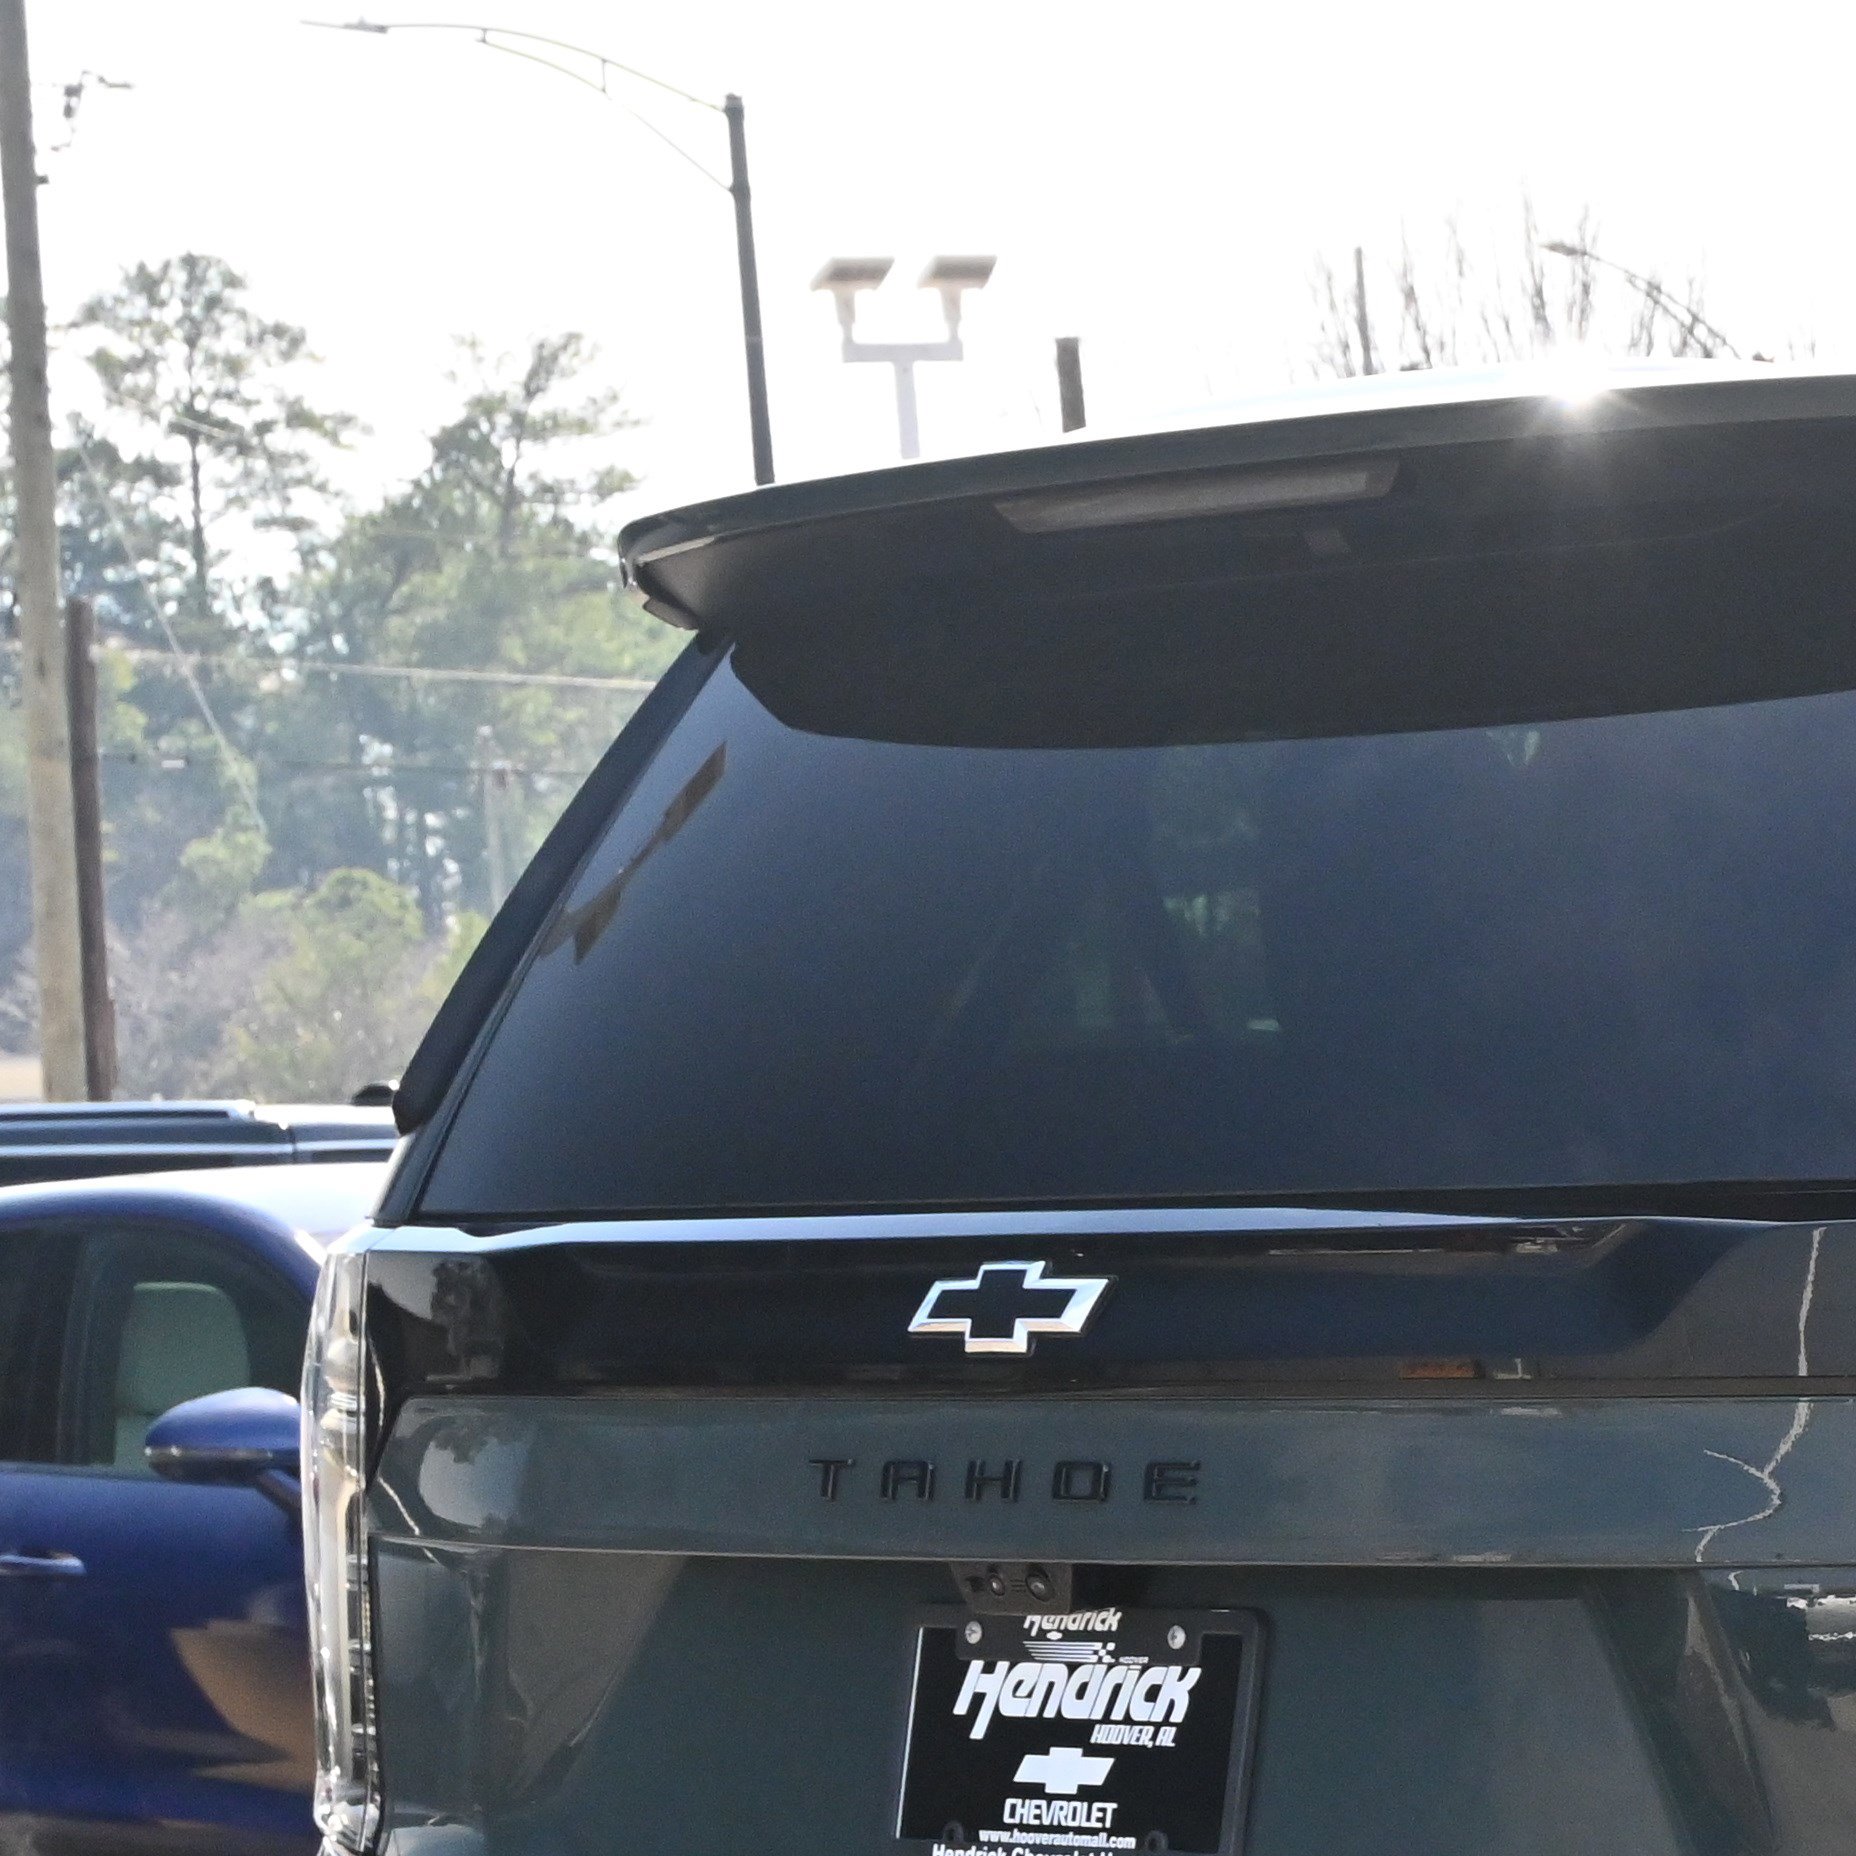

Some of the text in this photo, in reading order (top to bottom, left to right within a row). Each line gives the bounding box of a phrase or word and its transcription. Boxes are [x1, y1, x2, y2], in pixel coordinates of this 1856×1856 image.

[807, 1457, 1203, 1505] TAHOE
[953, 1659, 1202, 1740] Hendrick
[1090, 1724, 1177, 1748] HOOVER, AL
[1003, 1797, 1118, 1828] CHEVROLET
[979, 1828, 1136, 1850] www.hooverautomall.com
